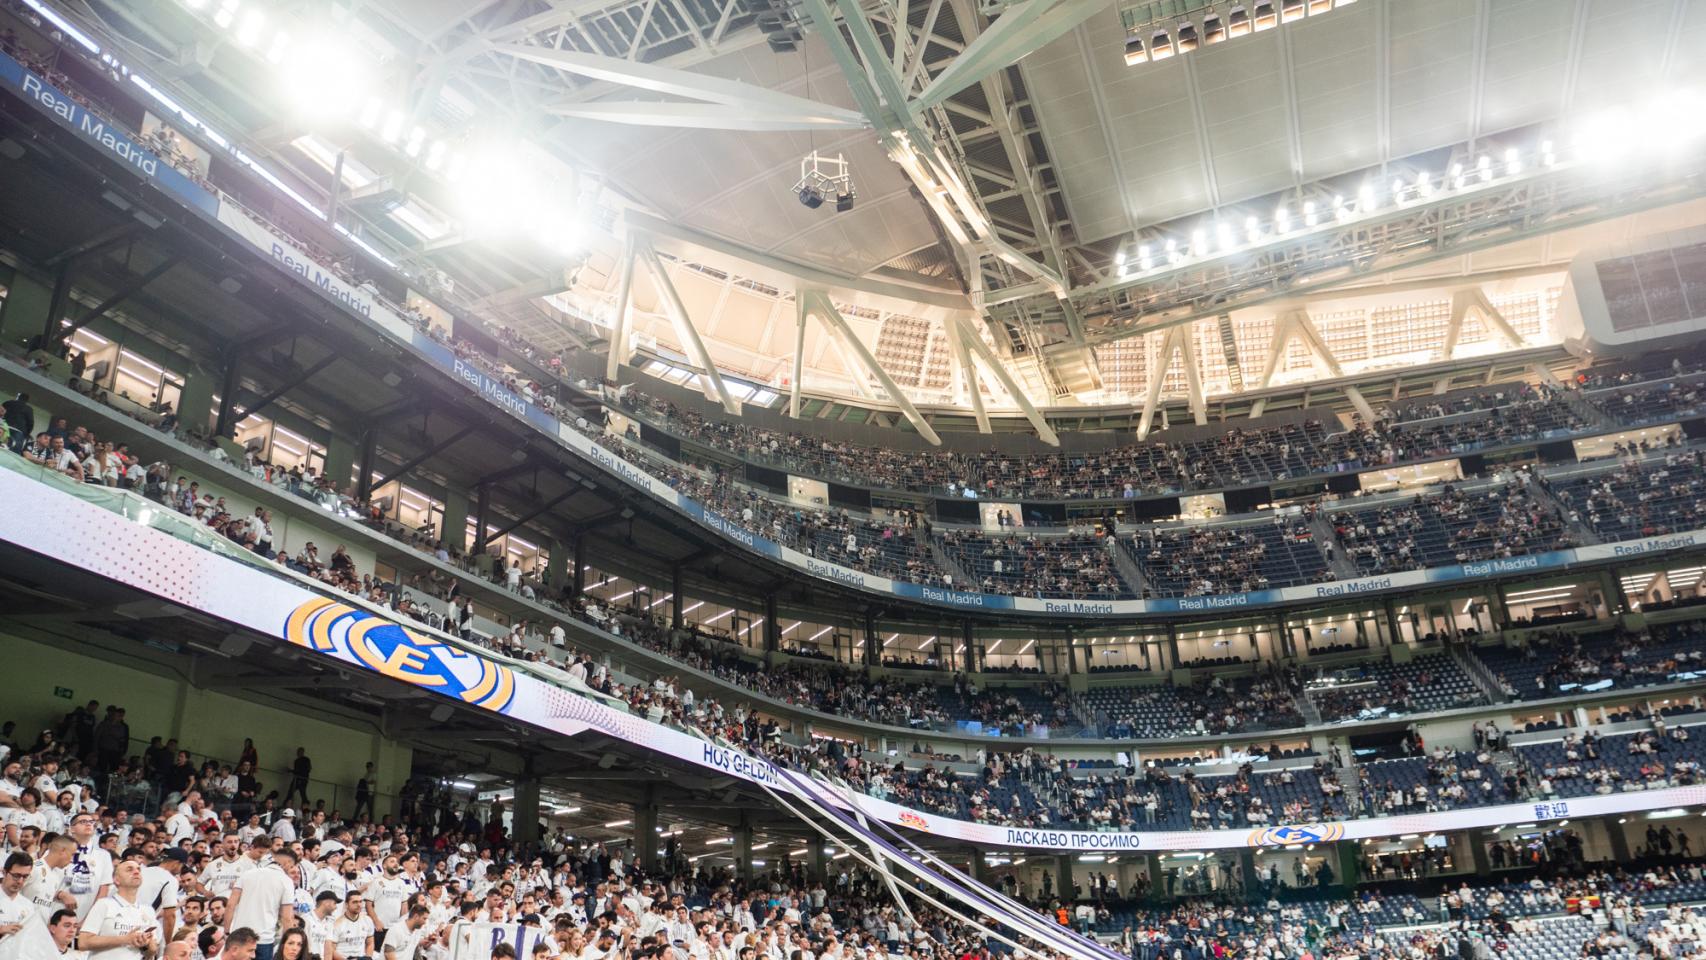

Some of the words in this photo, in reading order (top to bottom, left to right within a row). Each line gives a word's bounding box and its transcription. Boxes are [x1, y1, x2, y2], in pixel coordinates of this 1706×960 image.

[22, 74, 76, 123] Real
[81, 113, 157, 177] Madrid
[271, 242, 310, 277] Real
[314, 271, 371, 318] Madrid
[454, 359, 482, 388] Real
[484, 378, 527, 416] Madrid
[590, 446, 614, 467] Real
[616, 461, 652, 490] Madrid
[703, 510, 722, 530] Real
[723, 521, 753, 546] Madrid
[1613, 543, 1645, 556] Real
[1647, 535, 1696, 552] Madrid
[806, 559, 829, 576] Real
[831, 567, 865, 587] Madrid
[1463, 563, 1492, 577] Real
[1493, 556, 1538, 572] Madrid
[922, 587, 945, 601] Real
[946, 592, 983, 606] Madrid
[1316, 584, 1345, 597] Real
[1347, 577, 1392, 594] Madrid
[1045, 602, 1071, 613] Real
[1073, 603, 1113, 614] Madrid
[1178, 598, 1204, 610] Real
[1206, 593, 1247, 608] Madrid
[1007, 829, 1068, 847] ЛАСКАВО
[1071, 833, 1140, 848] ПРОСИМО
